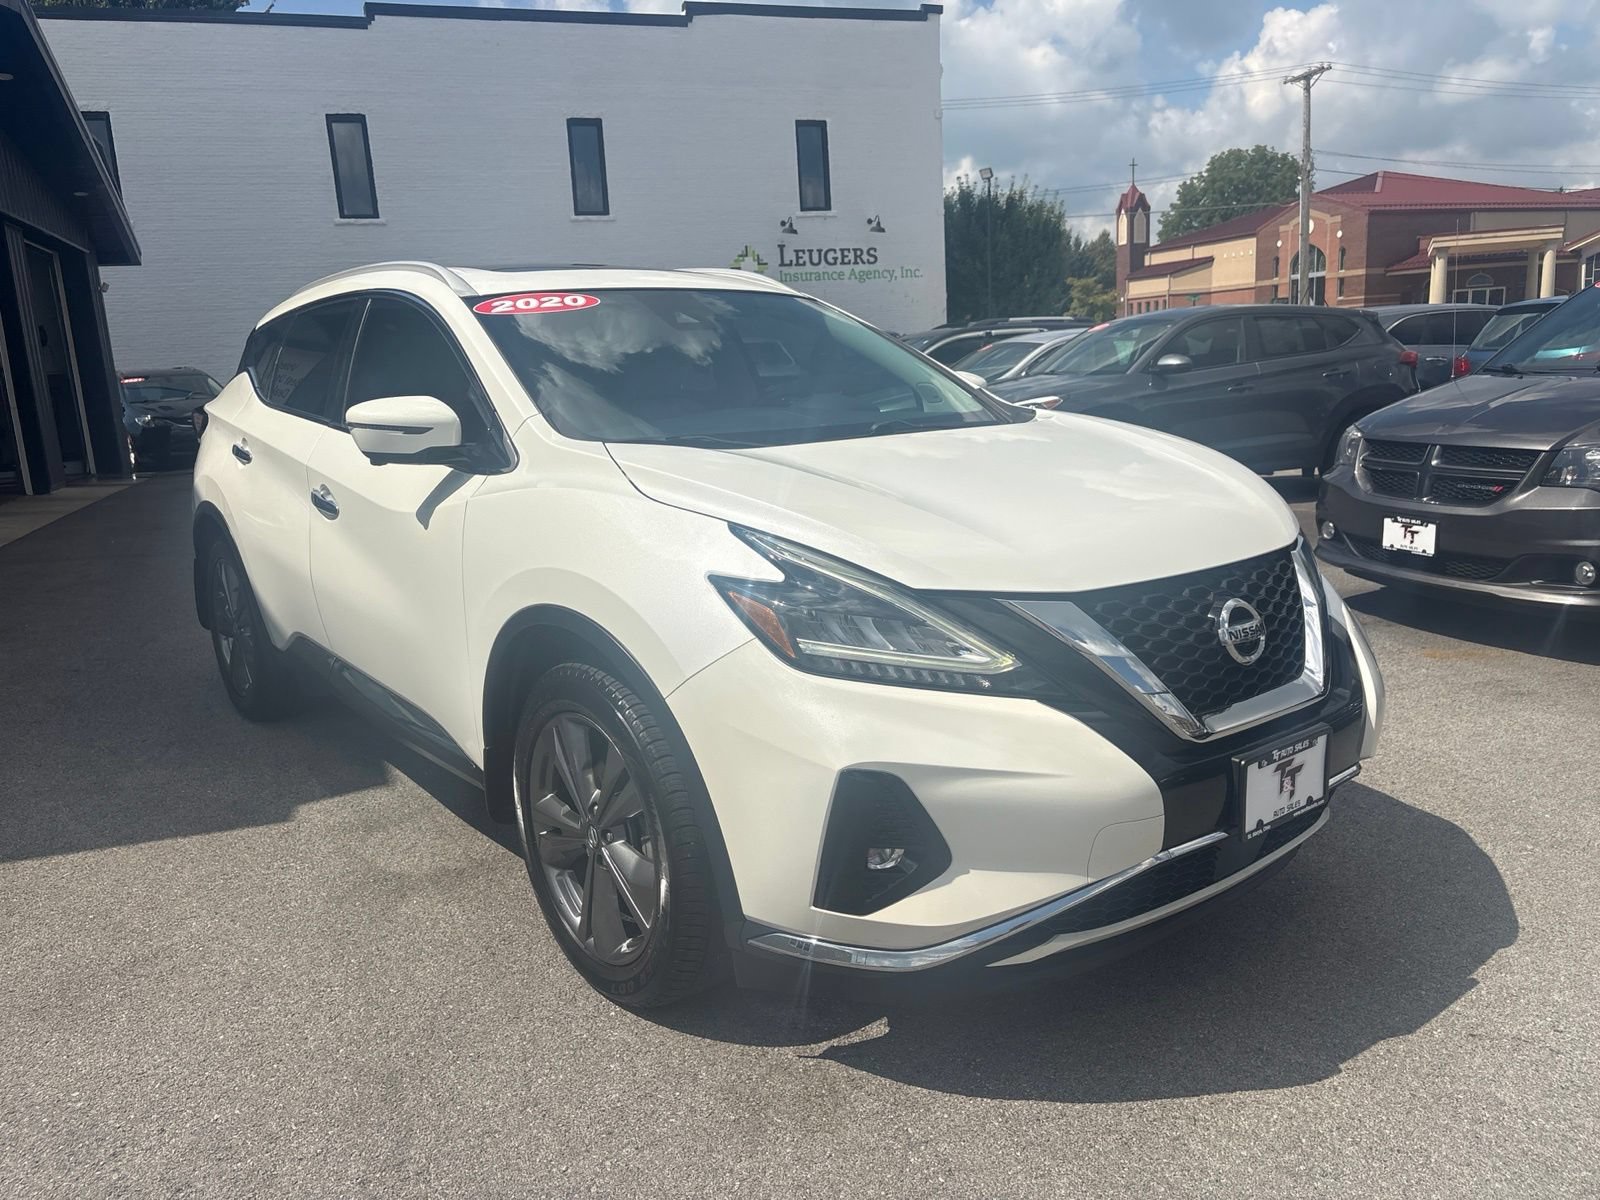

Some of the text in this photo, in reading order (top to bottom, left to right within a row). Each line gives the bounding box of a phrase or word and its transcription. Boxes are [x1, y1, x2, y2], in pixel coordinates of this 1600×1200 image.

[777, 244, 878, 267] LEUGERS
[779, 266, 924, 284] Insurance Agency, Inc.
[491, 295, 587, 313] 2020
